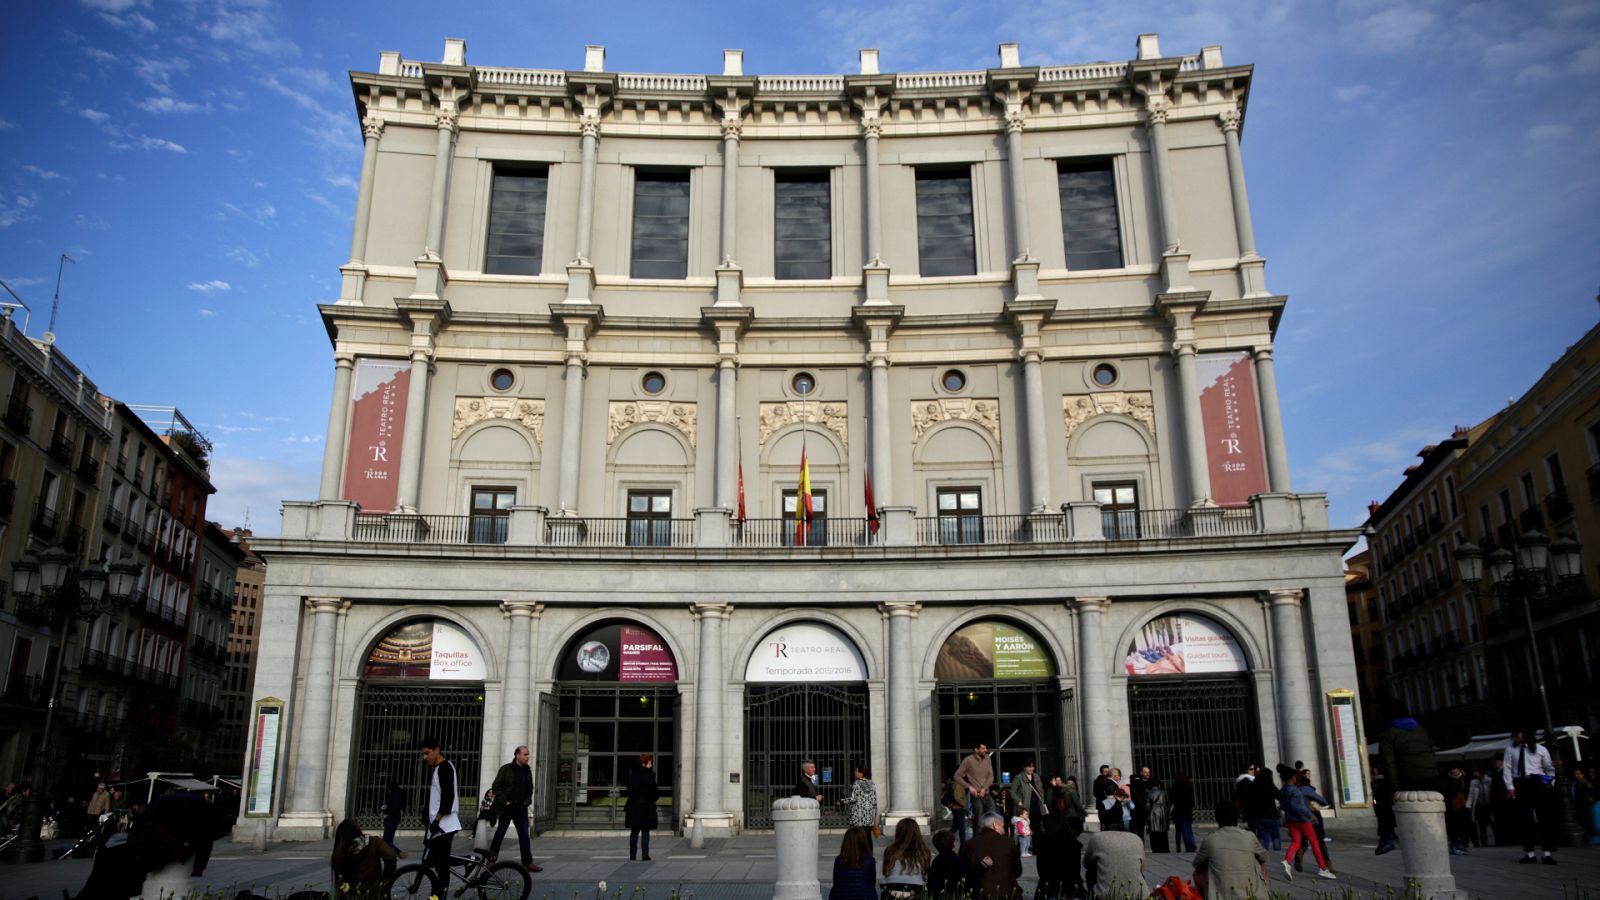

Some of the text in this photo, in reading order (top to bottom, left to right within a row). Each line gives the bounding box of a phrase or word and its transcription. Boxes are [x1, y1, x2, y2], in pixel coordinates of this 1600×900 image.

[382, 385, 391, 405] REAL
[1223, 377, 1235, 429] TEATRO REAL
[379, 407, 388, 437] TEATRO
[995, 634, 1025, 643] MOISÉS
[1003, 642, 1034, 650] AARÓN
[434, 650, 469, 659] Taquillas
[450, 659, 473, 667] office
[765, 666, 852, 676] Temporada 2015/2016
